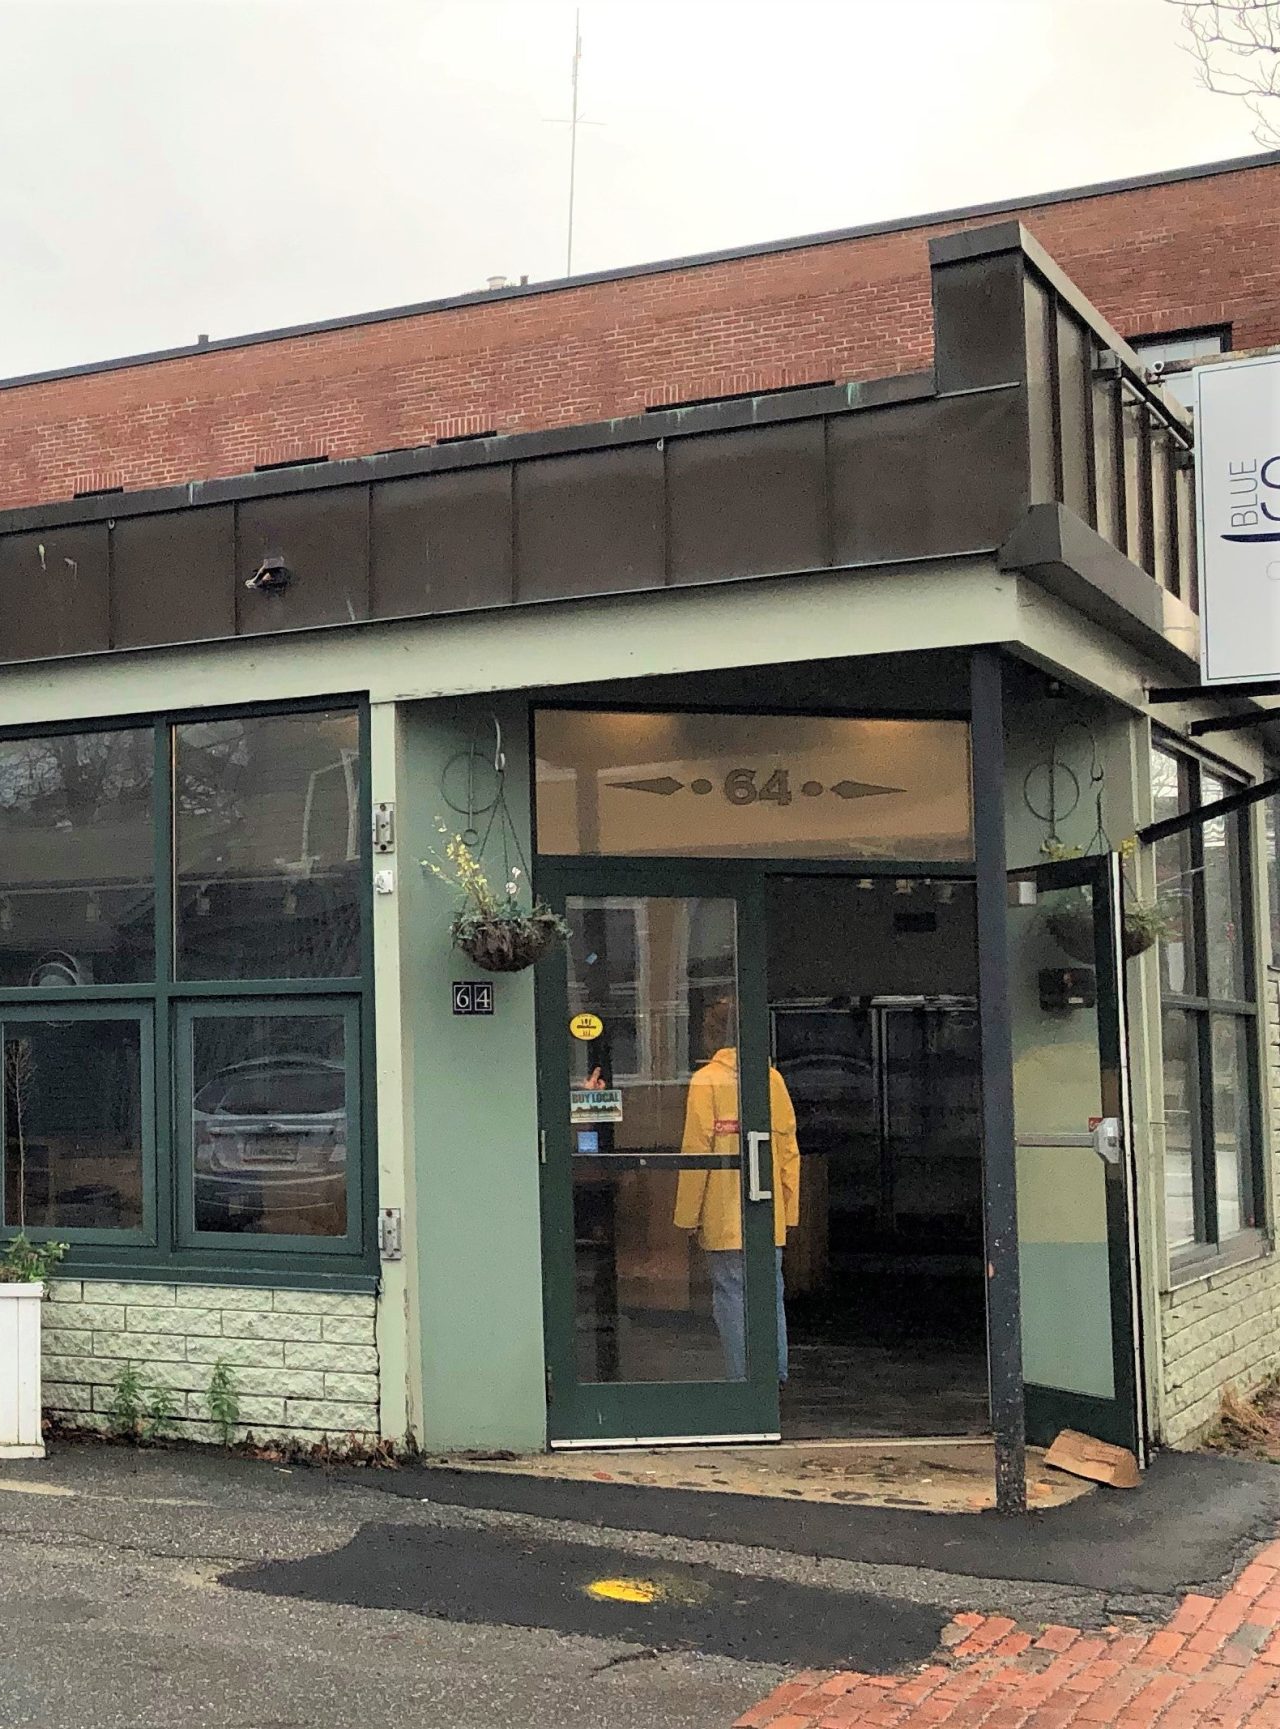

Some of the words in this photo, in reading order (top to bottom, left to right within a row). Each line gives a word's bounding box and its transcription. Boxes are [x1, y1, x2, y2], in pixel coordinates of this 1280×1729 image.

[1229, 458, 1258, 528] BLUE
[724, 767, 793, 806] 64
[456, 987, 491, 1008] 64
[572, 1092, 591, 1104] BUY
[592, 1090, 619, 1103] LOCAL
